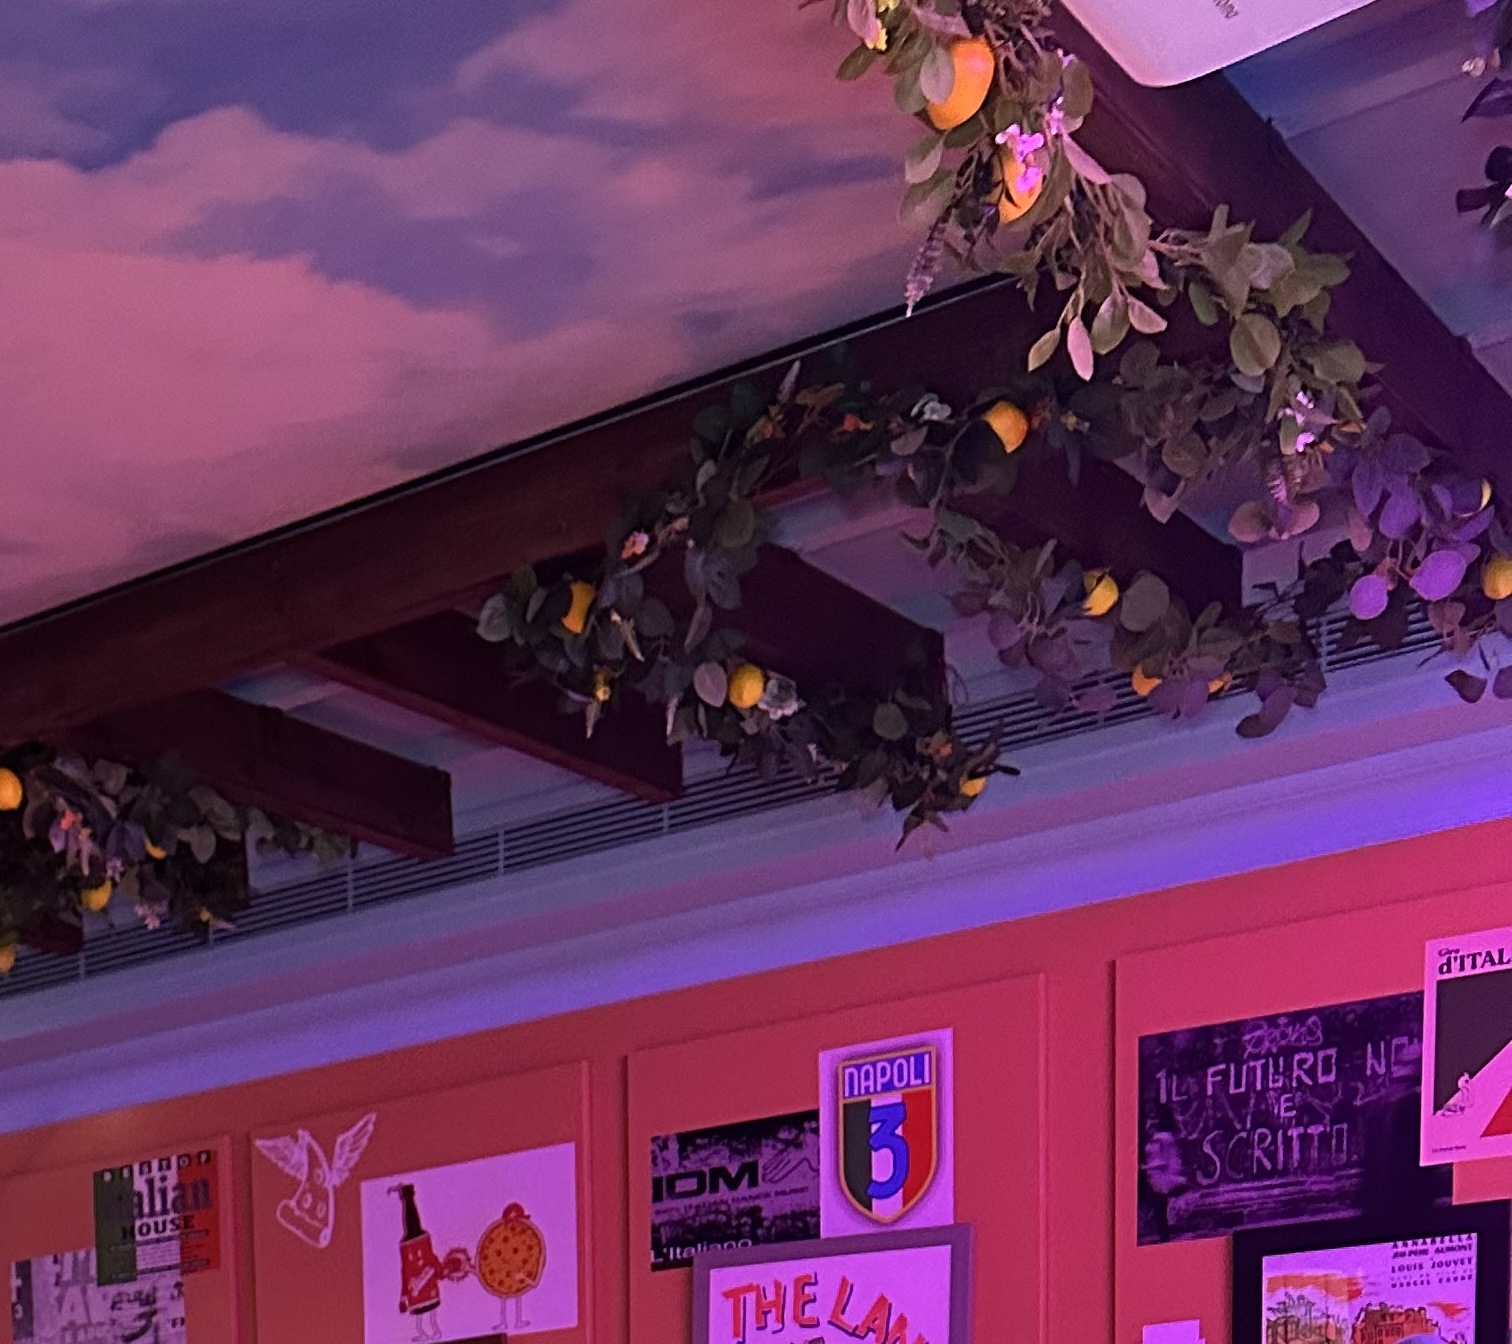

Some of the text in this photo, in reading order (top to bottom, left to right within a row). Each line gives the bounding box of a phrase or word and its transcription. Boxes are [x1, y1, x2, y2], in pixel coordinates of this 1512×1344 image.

[1438, 948, 1512, 975] d'ITAL
[844, 1052, 931, 1098] NAPOLI
[1206, 1047, 1338, 1098] FUTURO
[866, 1101, 910, 1200] 3
